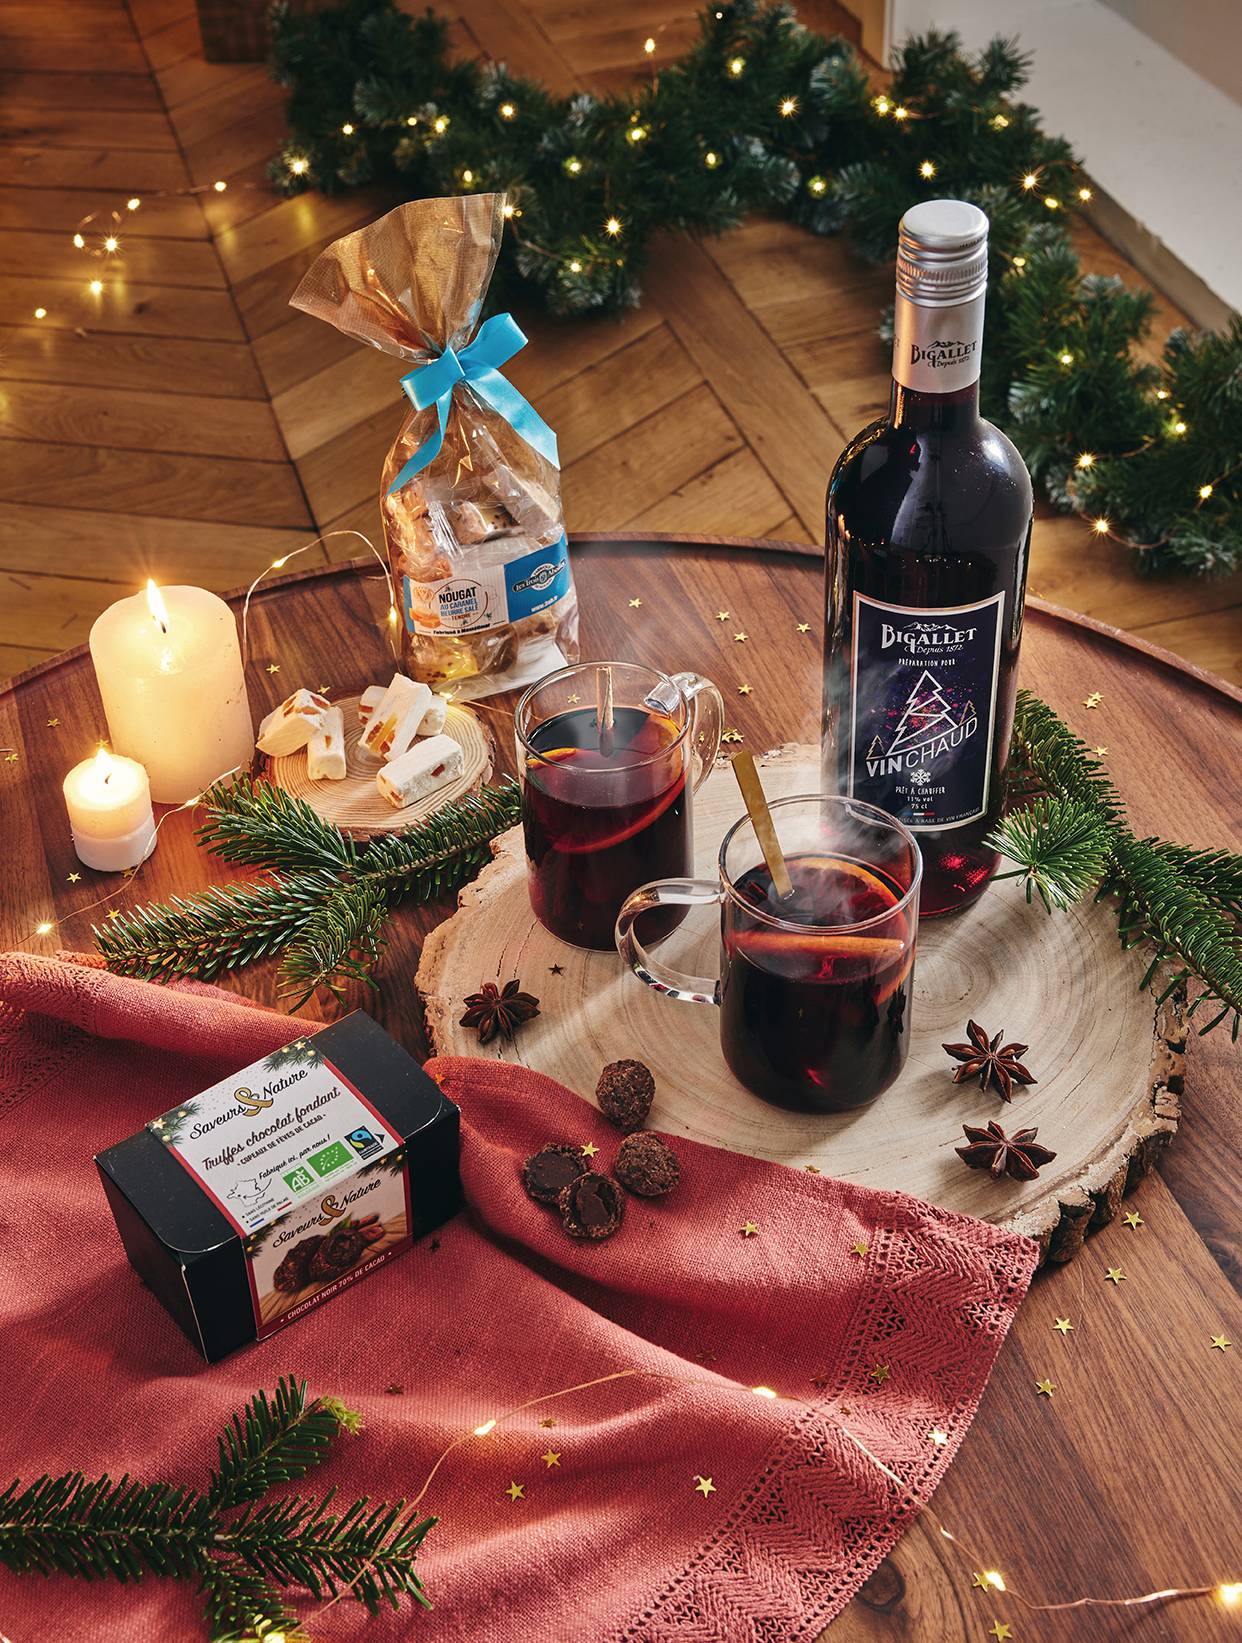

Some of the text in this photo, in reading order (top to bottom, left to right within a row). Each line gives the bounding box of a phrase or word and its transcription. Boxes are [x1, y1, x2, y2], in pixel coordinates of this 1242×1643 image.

[911, 340, 977, 368] BIGALLET
[439, 586, 477, 604] NOUGAT
[449, 598, 478, 609] CARAMEL
[881, 623, 977, 654] BIGALLET
[916, 644, 964, 655] Depuis 1872
[940, 658, 956, 666] POUR
[917, 786, 946, 795] CHAUFFER
[189, 1105, 246, 1140] Saveurs
[263, 1069, 308, 1100] Nature
[202, 1086, 341, 1171] Truffes chocolat fondant
[240, 1146, 268, 1165] COPEAUX
[267, 1140, 277, 1149] DE
[294, 1125, 304, 1134] DE
[303, 1115, 324, 1128] CACAO
[259, 1161, 287, 1179] Fabriqué
[299, 1146, 311, 1159] par
[291, 1172, 310, 1193] AB
[273, 1212, 325, 1248] Saveurs
[340, 1178, 381, 1209] Nature
[287, 1255, 386, 1320] CHOCOLAT NOIR 70% DE CACAO
